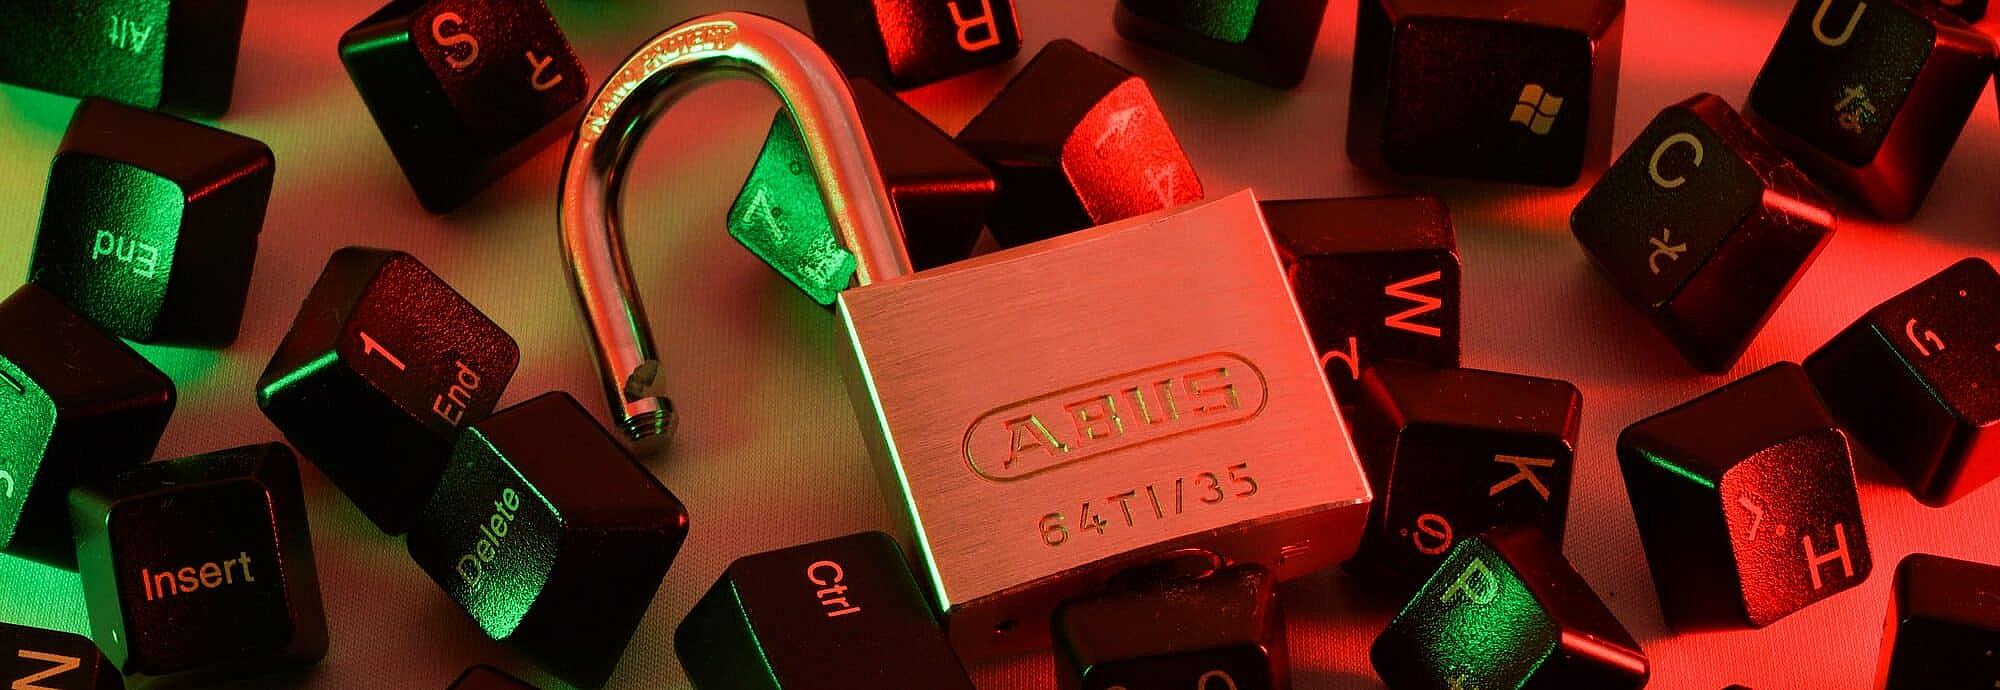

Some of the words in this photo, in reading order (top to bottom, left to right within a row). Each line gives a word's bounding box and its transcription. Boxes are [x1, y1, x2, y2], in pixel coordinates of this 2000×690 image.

[108, 15, 152, 55] Alt
[432, 12, 479, 70] S
[954, 0, 1001, 52] R
[1811, 0, 1866, 47] U
[1648, 132, 1704, 190] C
[91, 230, 160, 280] End
[1384, 271, 1442, 337] W
[359, 331, 406, 371] 1
[432, 360, 482, 427] End
[1002, 367, 1242, 470] ABUS
[1489, 453, 1552, 501] K
[455, 485, 520, 591] Delete
[1801, 522, 1855, 590] H
[141, 550, 256, 602] Insert
[806, 559, 861, 618] Ctrl
[1440, 557, 1498, 606] P
